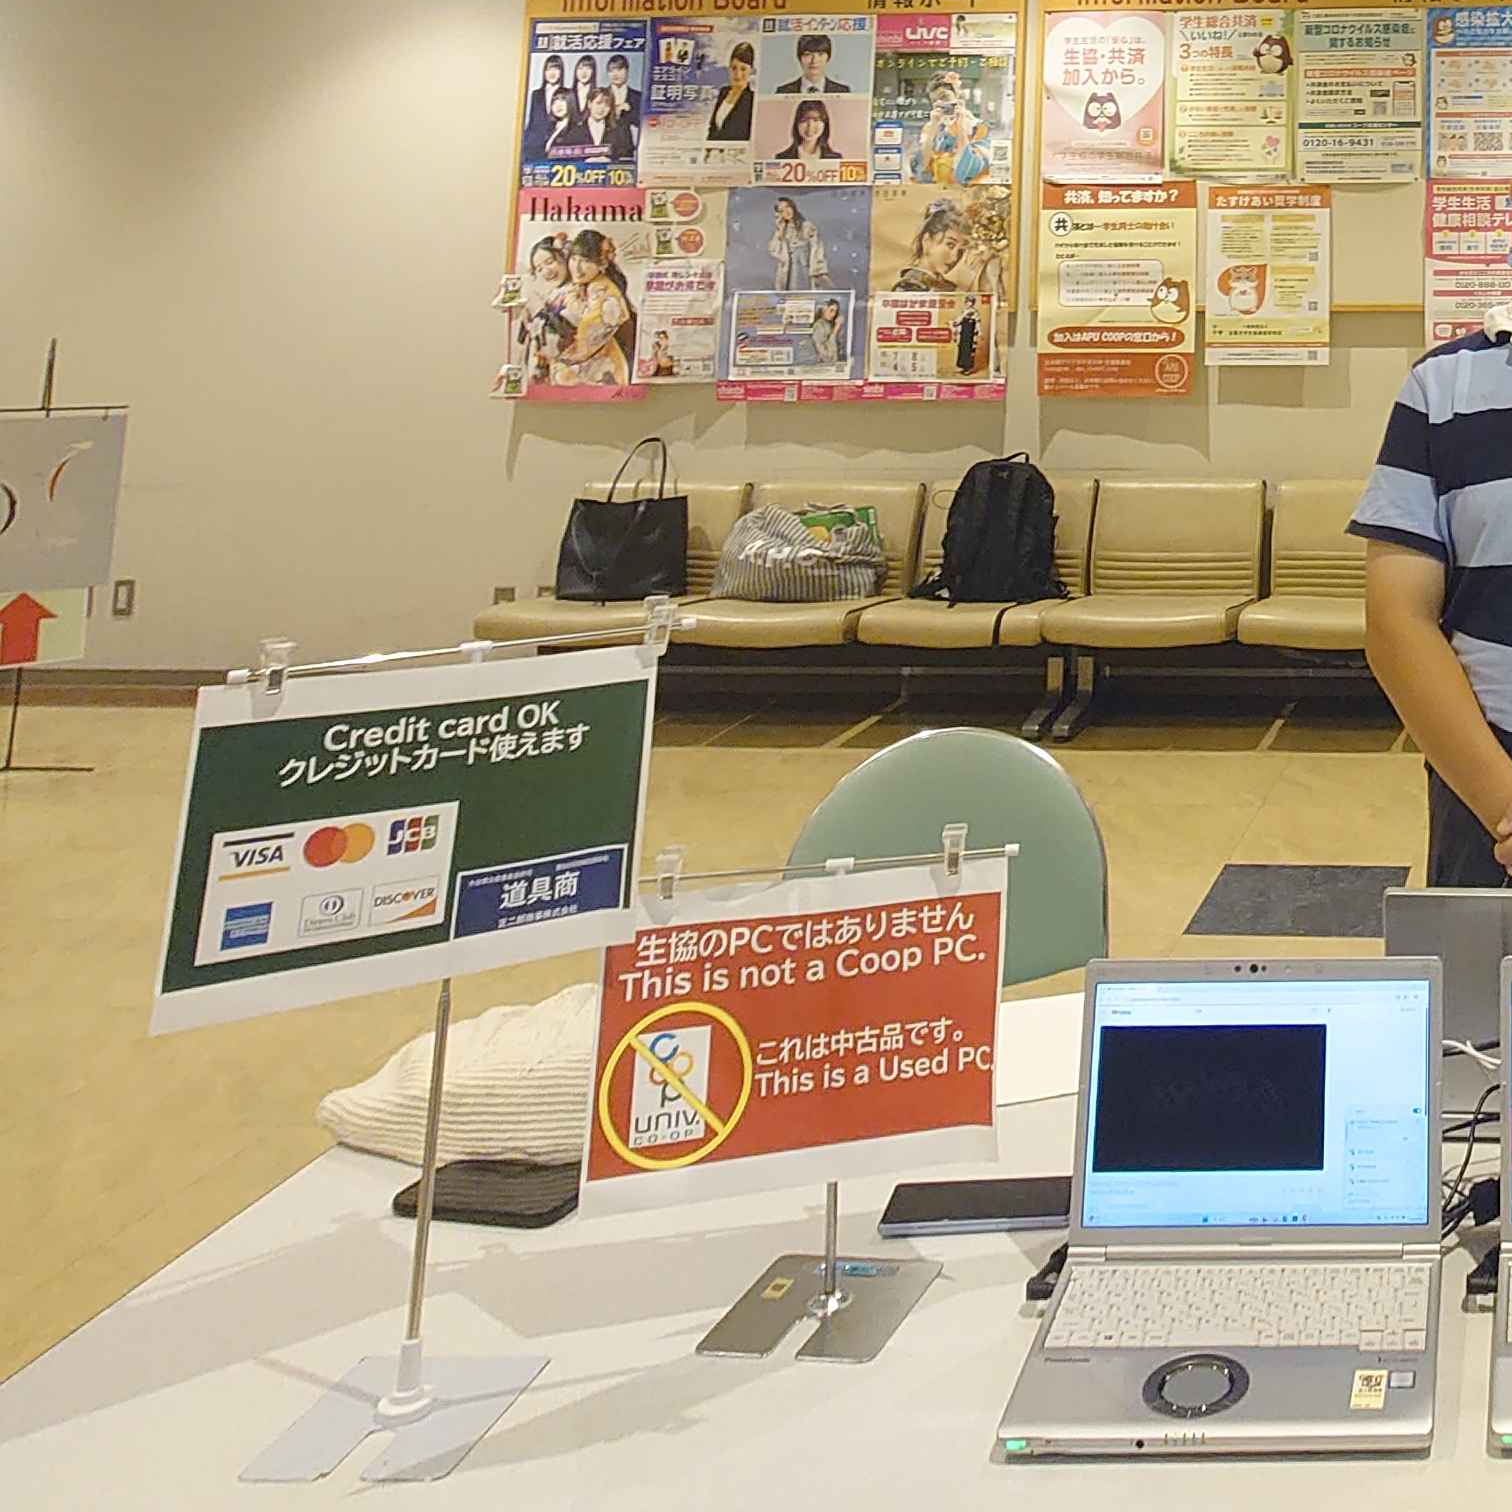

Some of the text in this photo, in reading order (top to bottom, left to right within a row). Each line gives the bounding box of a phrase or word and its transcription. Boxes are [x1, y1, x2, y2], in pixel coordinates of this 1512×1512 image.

[1179, 15, 1257, 28] 学生総合共済
[1063, 48, 1146, 66] 生協・共済
[1062, 67, 1146, 86] 加入から。
[530, 196, 643, 223] Hakama
[1432, 196, 1491, 211] 学生生活
[323, 699, 562, 752] Credit card OK
[278, 723, 592, 788] クレジットカード使えます
[388, 819, 438, 850] JCB
[230, 845, 284, 868] VISA
[374, 887, 435, 908] DISCOVER
[500, 871, 580, 909] 道具商
[636, 902, 975, 968] 生協のPCではありません
[619, 934, 986, 1002] This is not a Coop PC.
[755, 1016, 965, 1066] これは中古品です。
[755, 1066, 814, 1098] This
[823, 1063, 844, 1090] is
[853, 1063, 870, 1086] a
[879, 1050, 949, 1081] Used
